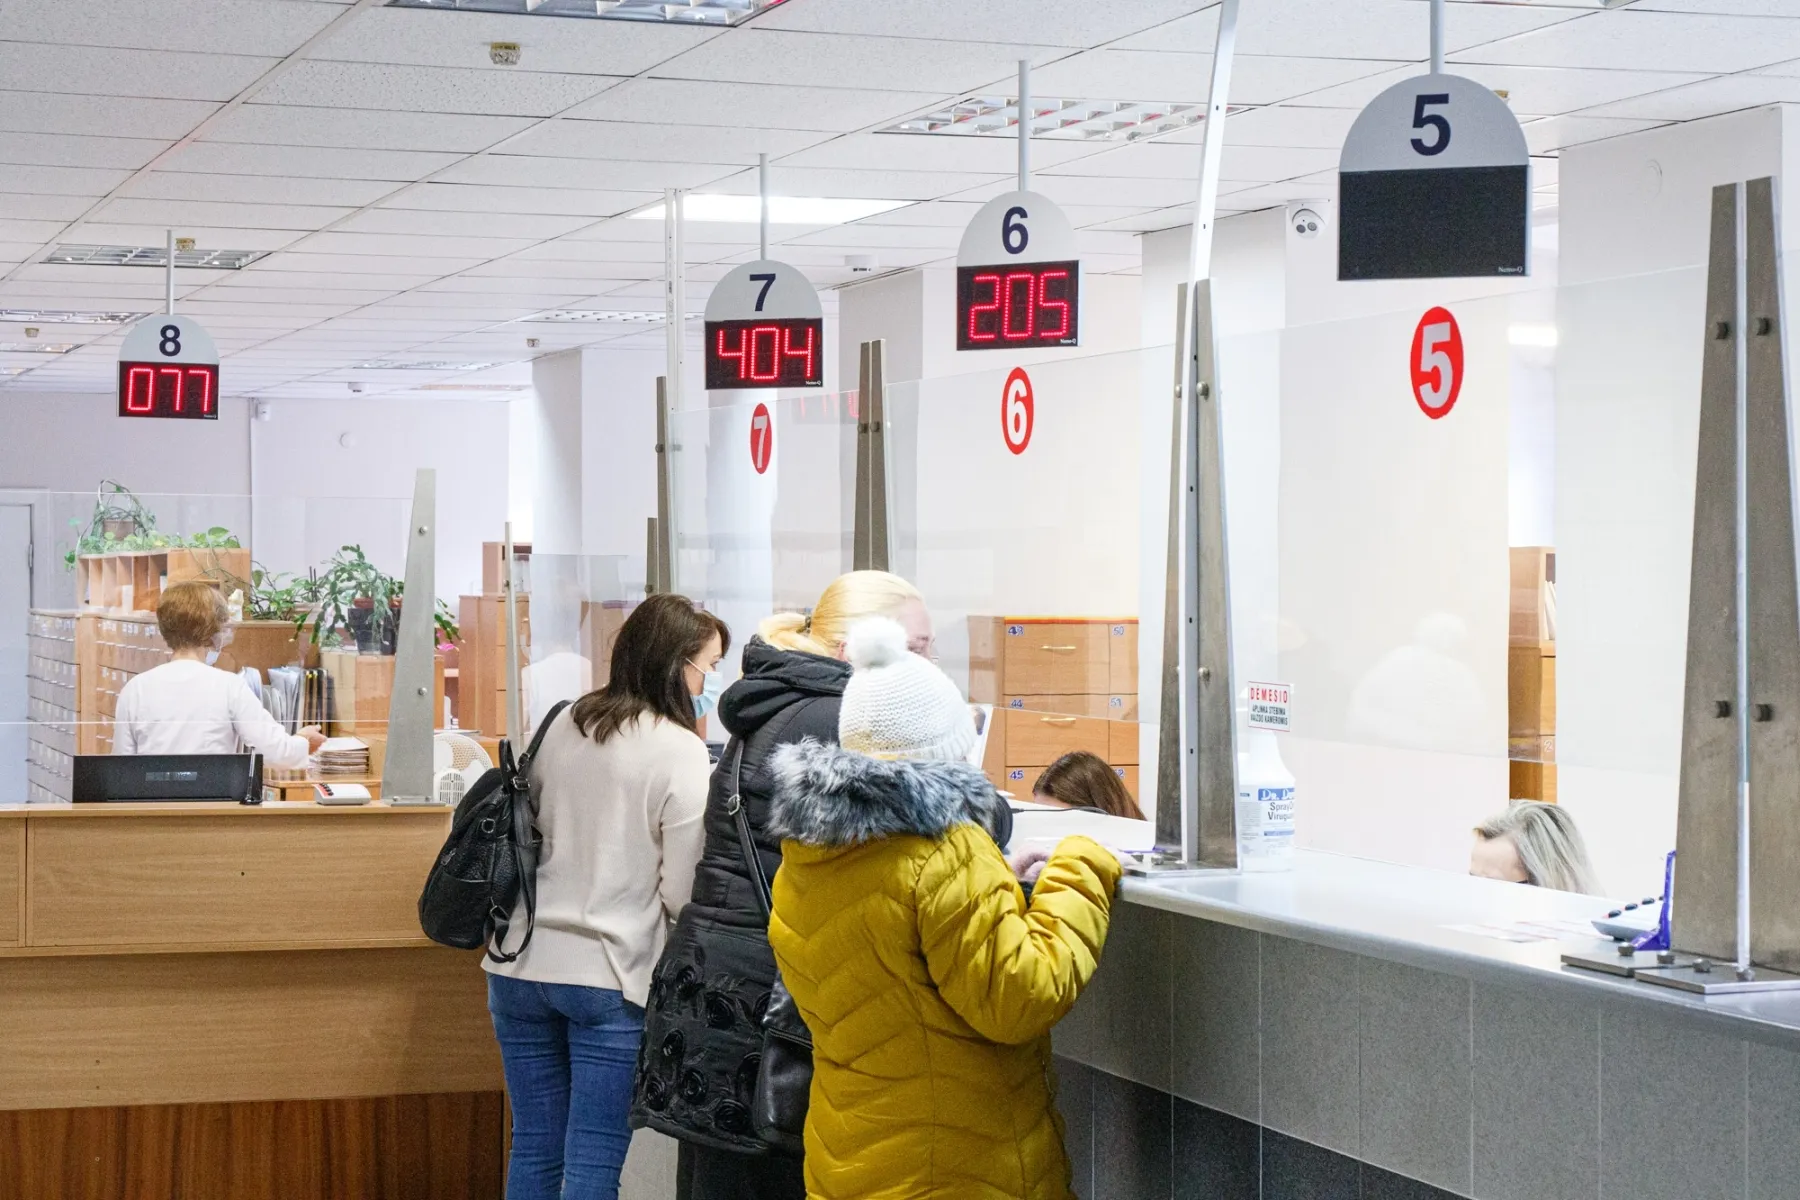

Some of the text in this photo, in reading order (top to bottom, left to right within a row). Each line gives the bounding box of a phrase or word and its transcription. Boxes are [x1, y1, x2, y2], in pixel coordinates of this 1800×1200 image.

[1410, 93, 1451, 156] 5
[1002, 206, 1029, 255] 6
[749, 273, 776, 311] 7
[970, 271, 1067, 339] 205
[159, 324, 181, 357] 8
[718, 326, 813, 380] 404
[1419, 321, 1454, 409] 5
[127, 367, 210, 412] 077
[1006, 378, 1028, 446] 6
[753, 414, 768, 469] 7
[1011, 699, 1023, 708] 44
[1010, 770, 1024, 780] 45
